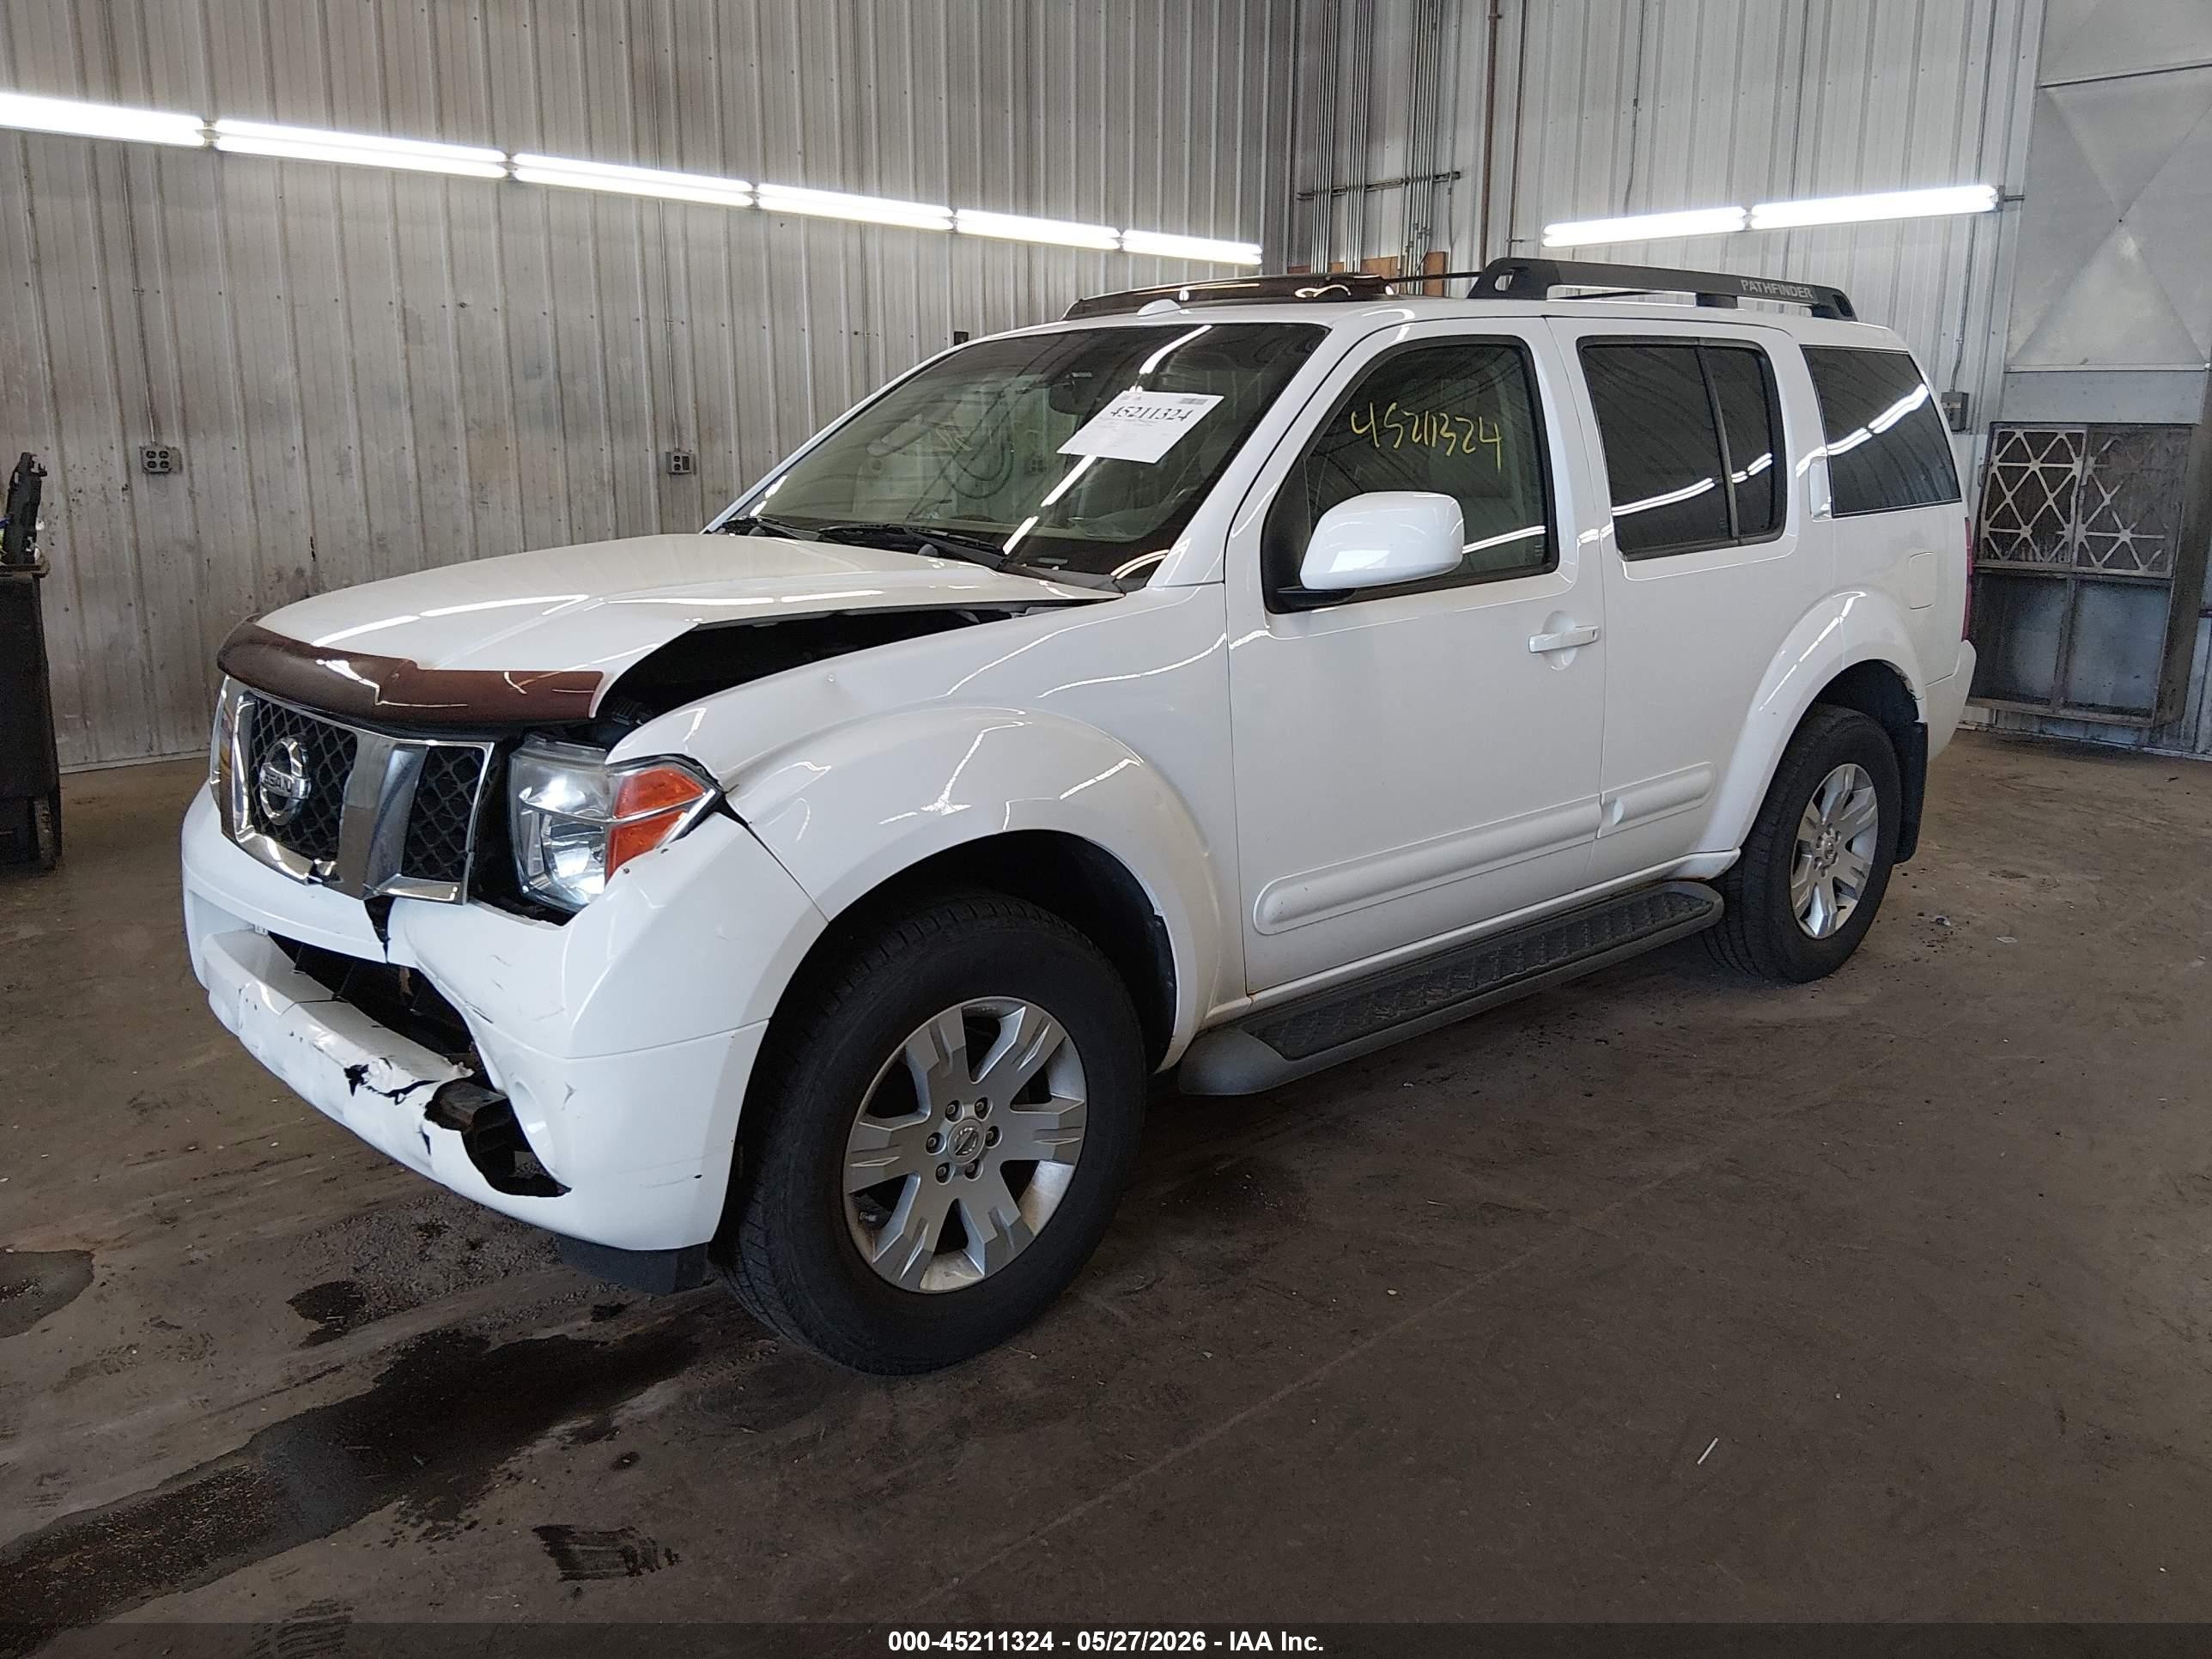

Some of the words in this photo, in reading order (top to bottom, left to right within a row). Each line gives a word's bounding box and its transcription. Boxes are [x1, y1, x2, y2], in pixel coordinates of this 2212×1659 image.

[1740, 279, 1814, 299] PATHFINDER
[1110, 405, 1194, 421] 45211324
[1351, 401, 1503, 473] 45211324
[260, 772, 293, 793] SSAN
